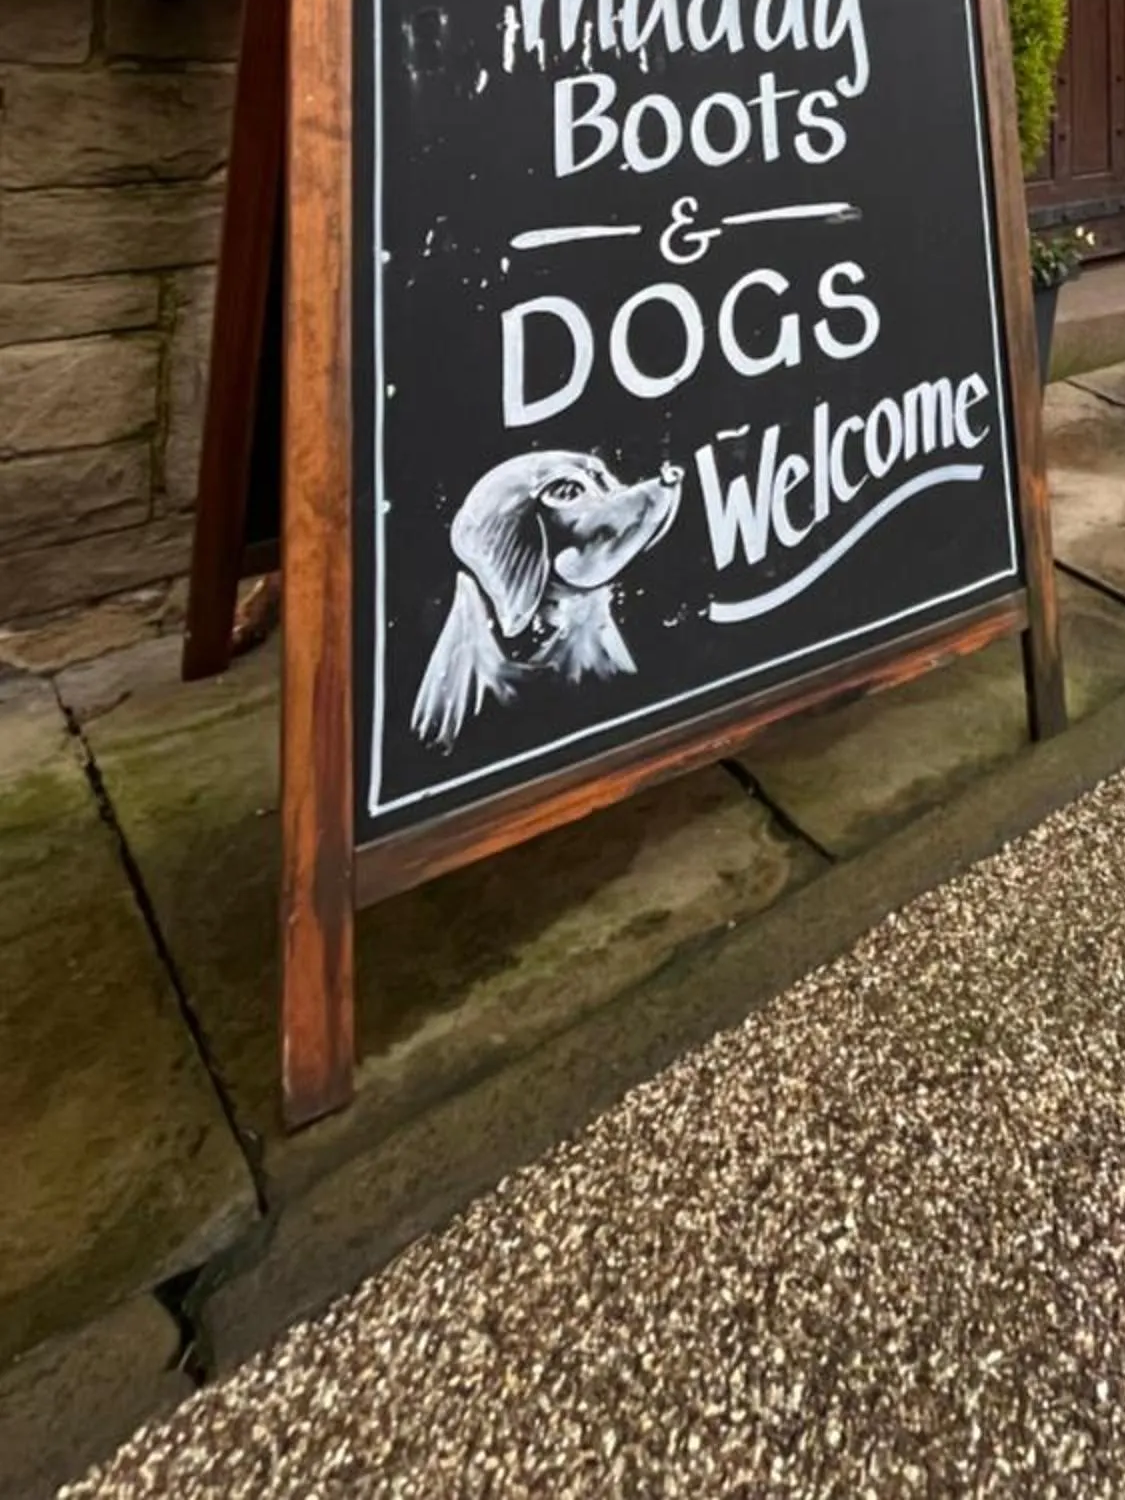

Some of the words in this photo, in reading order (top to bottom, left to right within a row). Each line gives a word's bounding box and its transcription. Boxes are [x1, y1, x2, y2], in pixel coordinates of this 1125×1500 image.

[660, 196, 722, 264] &
[501, 260, 881, 429] DOGS
[695, 372, 991, 570] Welcome
